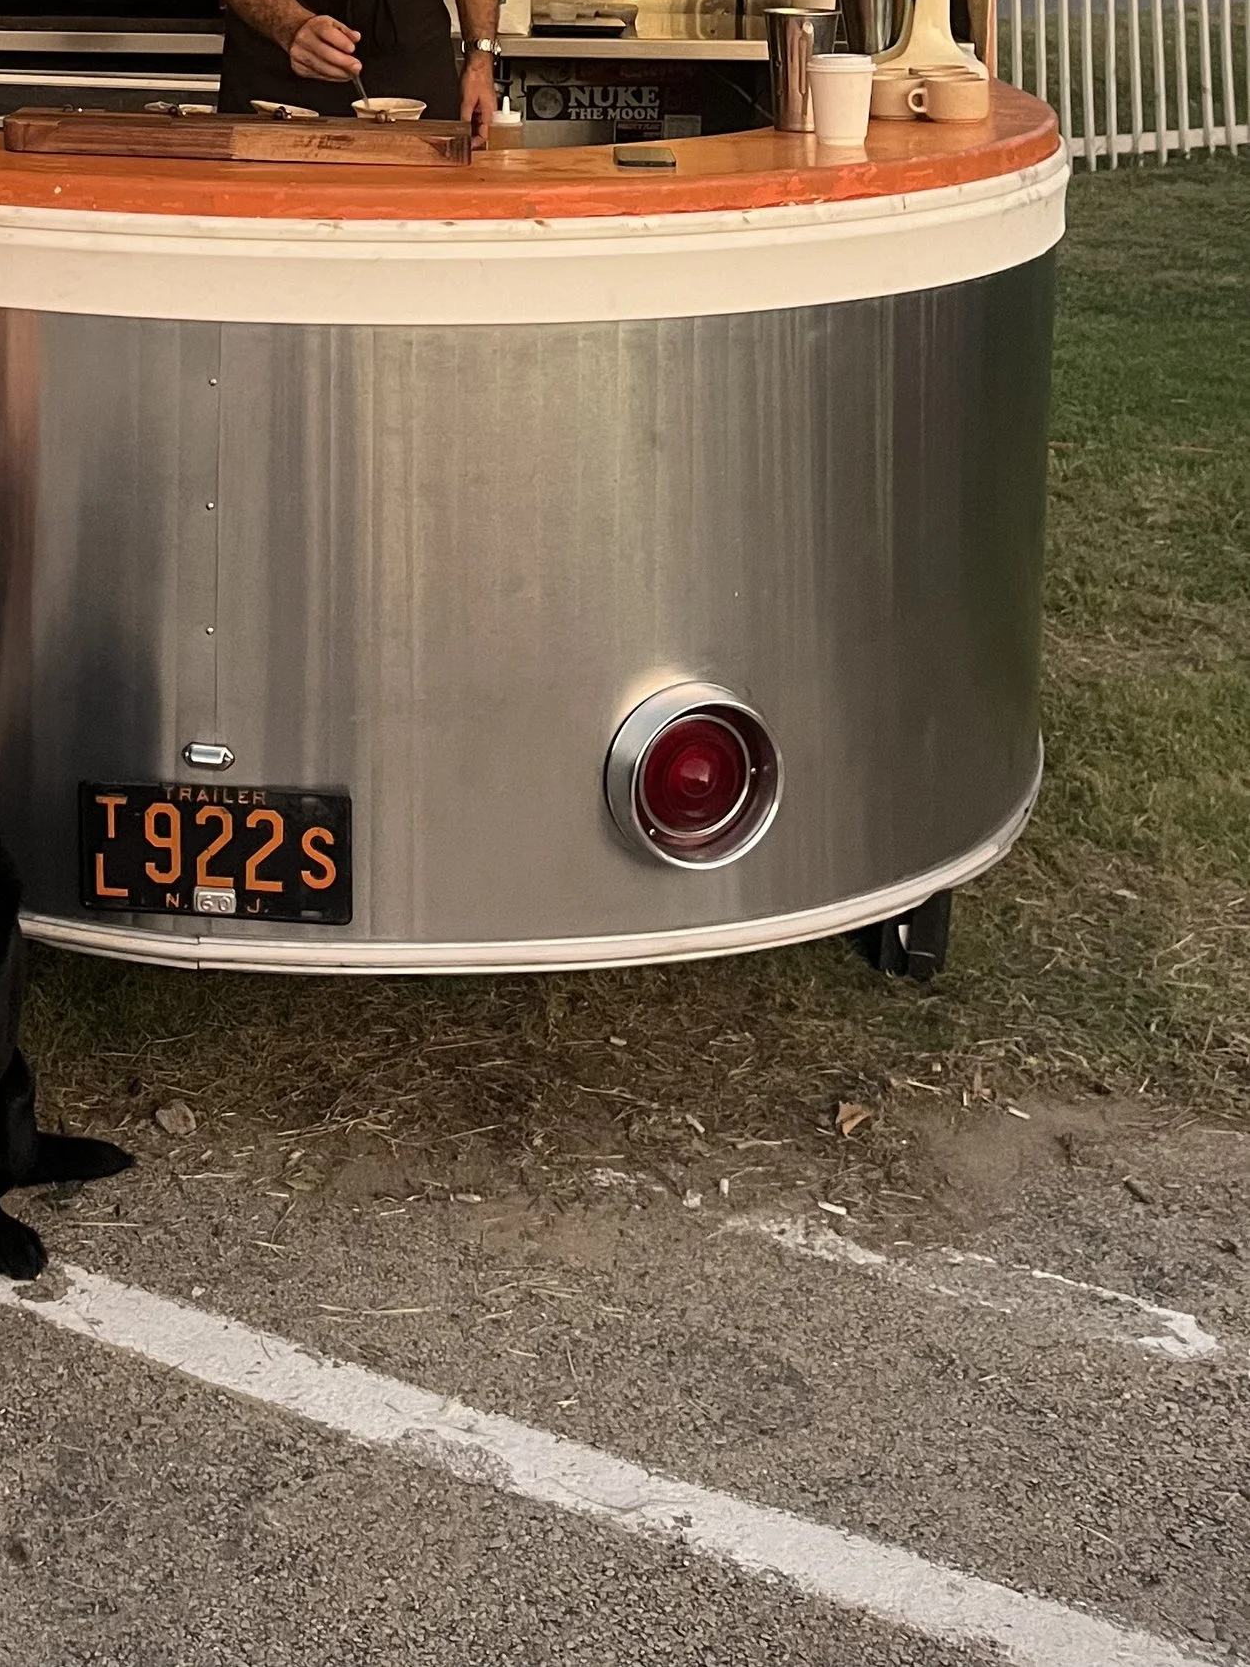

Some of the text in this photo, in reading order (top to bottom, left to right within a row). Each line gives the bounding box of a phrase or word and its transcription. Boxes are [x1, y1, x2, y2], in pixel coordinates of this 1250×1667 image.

[569, 86, 660, 107] NUKE
[567, 107, 659, 120] THE MOON
[163, 785, 267, 805] TRAILER
[200, 894, 231, 912] 60
